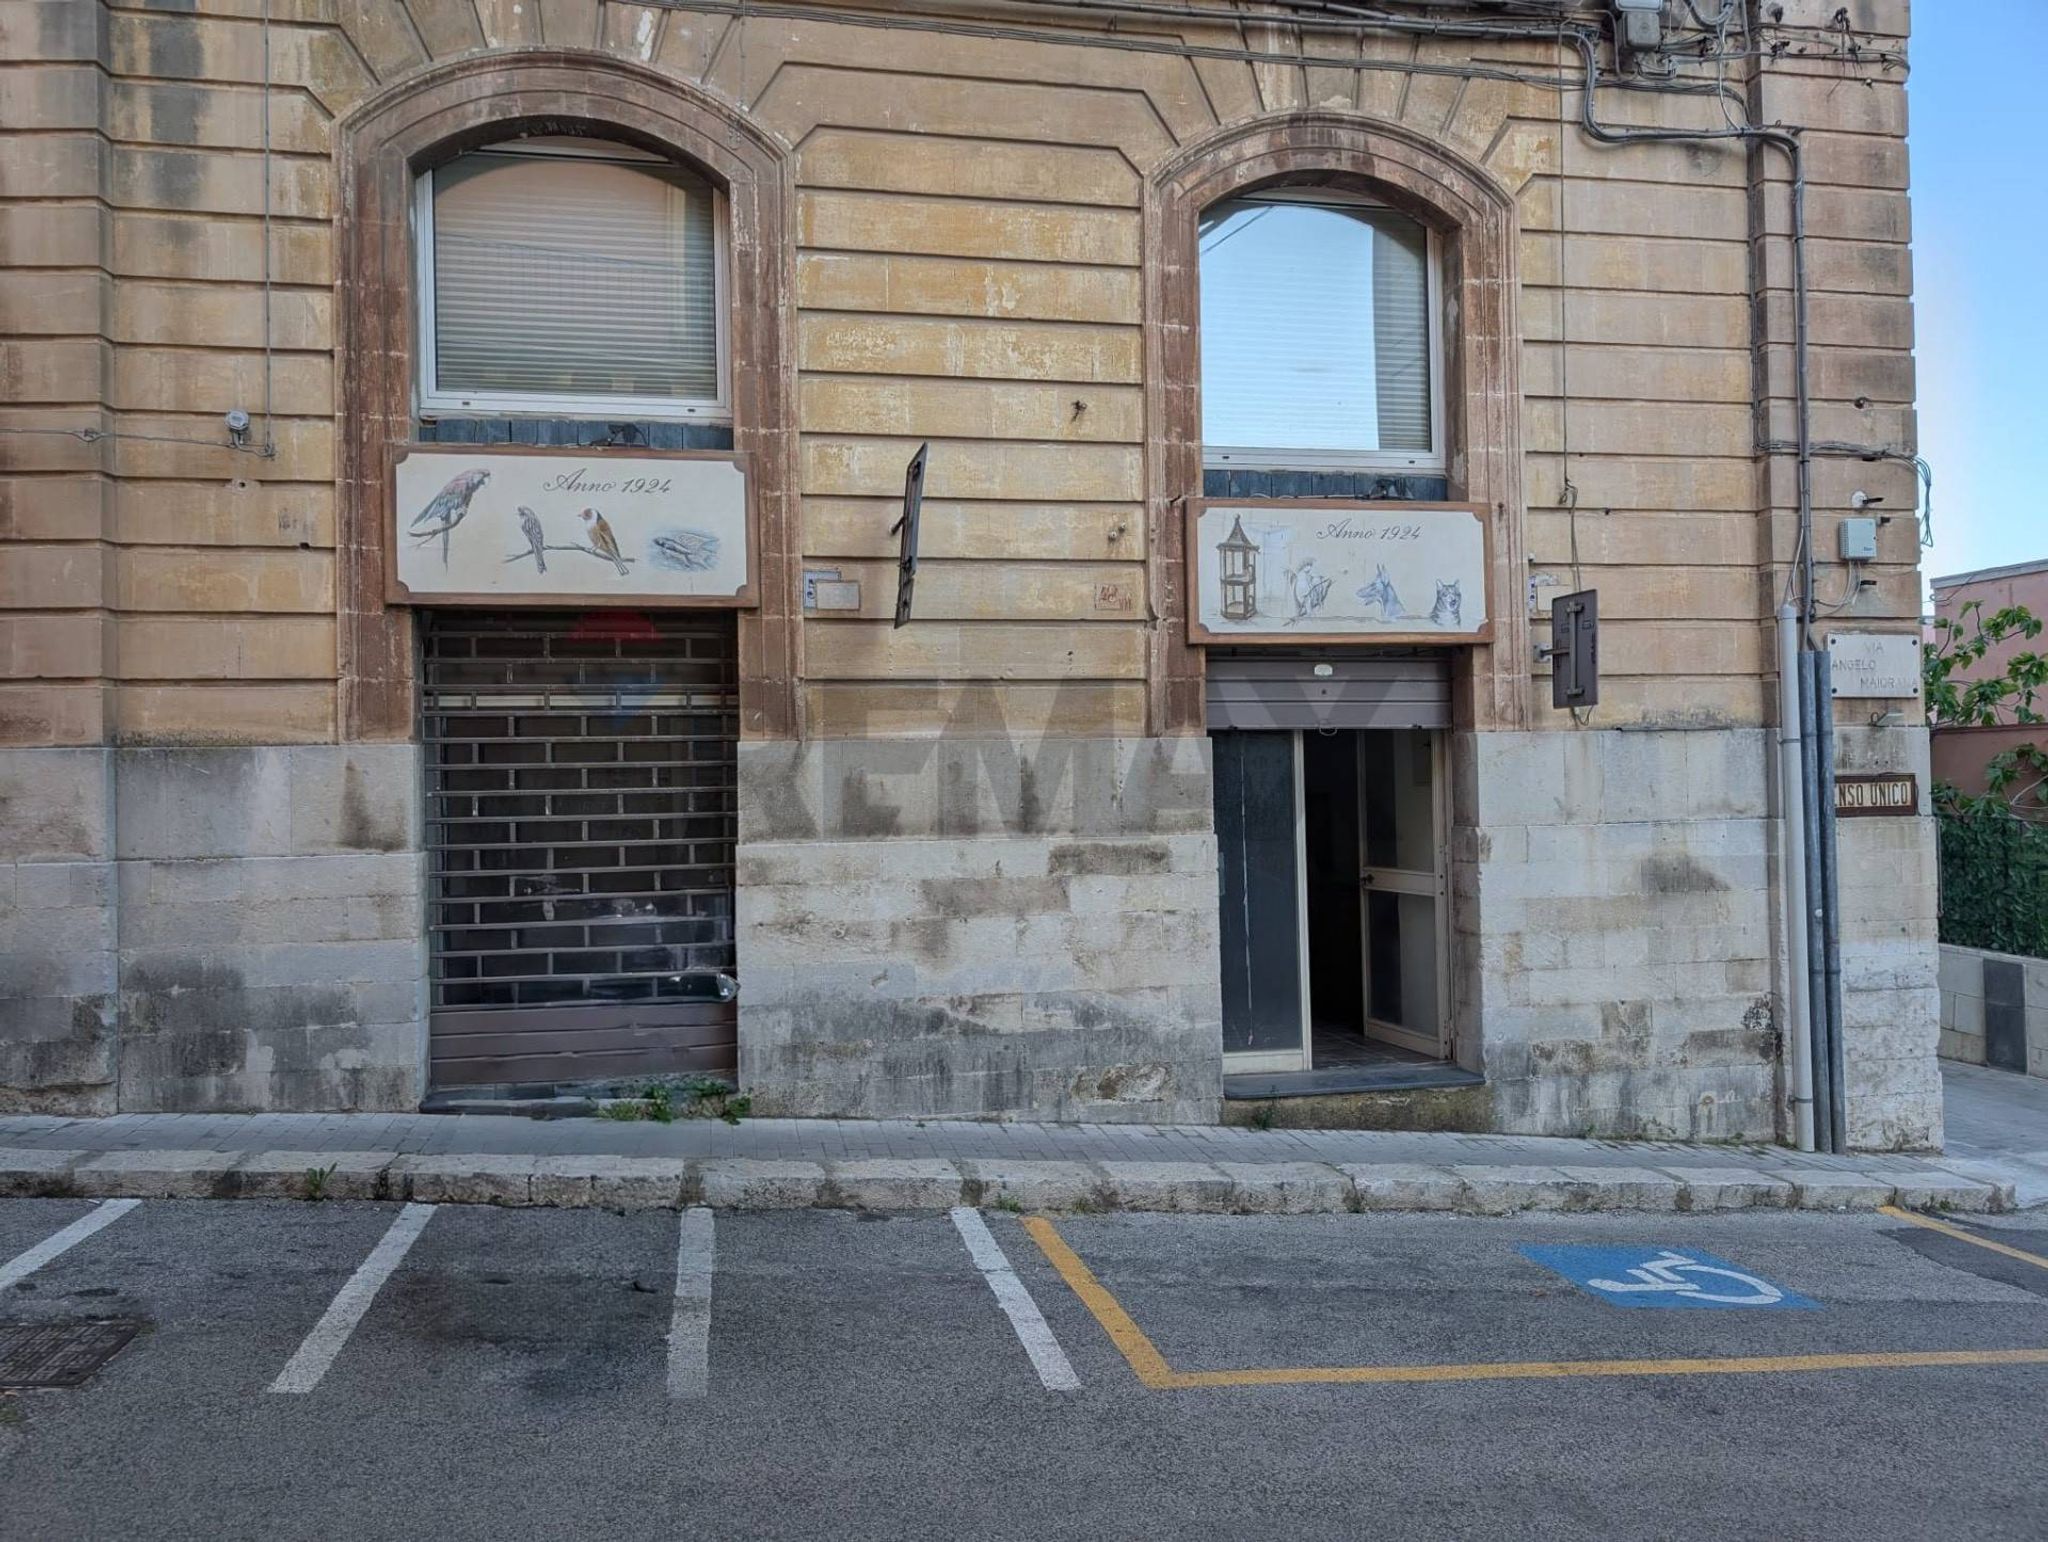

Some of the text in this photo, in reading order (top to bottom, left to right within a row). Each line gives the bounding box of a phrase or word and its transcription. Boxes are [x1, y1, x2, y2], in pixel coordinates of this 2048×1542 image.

[542, 467, 672, 494] Anno 1924
[1315, 518, 1422, 541] Anno 1924
[1831, 658, 1877, 672] ANGELO
[1860, 676, 1919, 689] MAIORA
[1834, 782, 1908, 807] NSO UNICO
